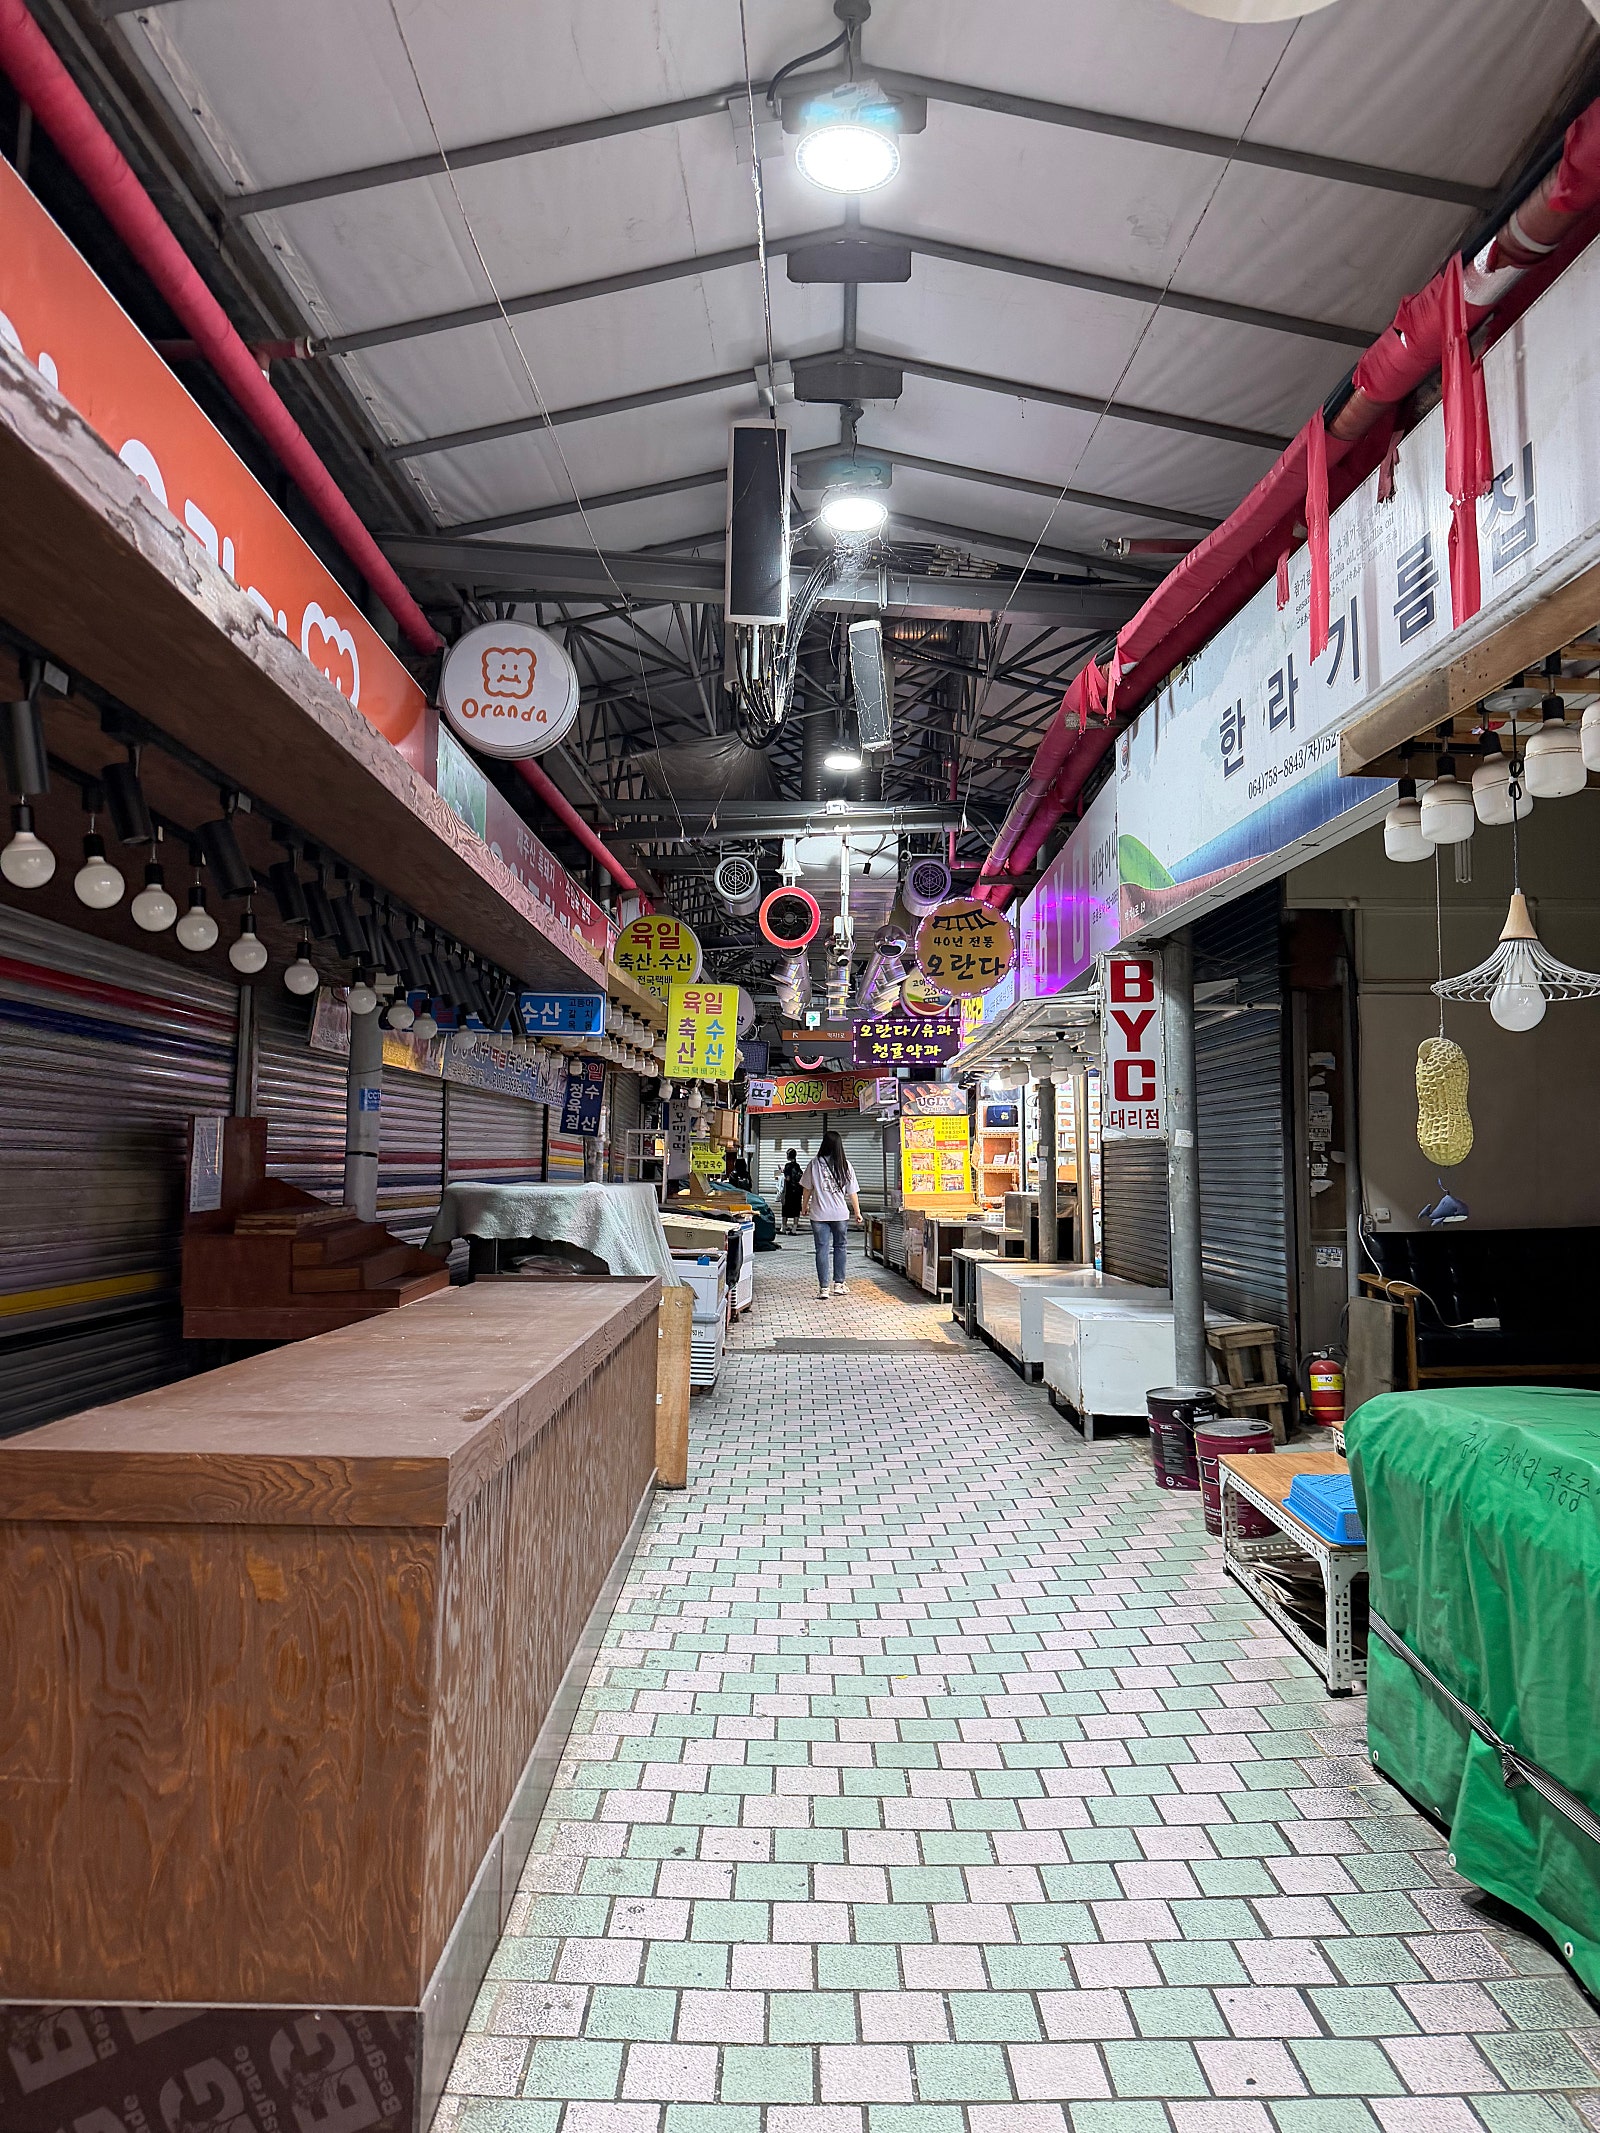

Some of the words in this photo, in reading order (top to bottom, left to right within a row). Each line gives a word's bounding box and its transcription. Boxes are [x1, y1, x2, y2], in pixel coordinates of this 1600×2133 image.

[461, 698, 548, 724] Oranda
[630, 922, 681, 950] 육일
[933, 936, 964, 948] 40년
[969, 936, 995, 948] 전통
[619, 953, 693, 972] 축산.수산
[926, 954, 1006, 981] 오란다
[637, 975, 673, 984] 전국택배
[521, 1001, 562, 1026] 수산
[568, 999, 594, 1008] 고등어
[682, 991, 724, 1015] 육일
[860, 1023, 954, 1039] 오란다/유과
[1110, 960, 1157, 1102] BYC
[872, 1043, 942, 1059] 청귤약과
[672, 1066, 727, 1077] 전국택배가능
[566, 1083, 584, 1131] 정육점
[581, 1084, 601, 1132] 수산
[916, 1096, 951, 1107] UGLY
[1110, 1108, 1160, 1130] 대리점
[672, 1111, 687, 1154] 오메기떡
